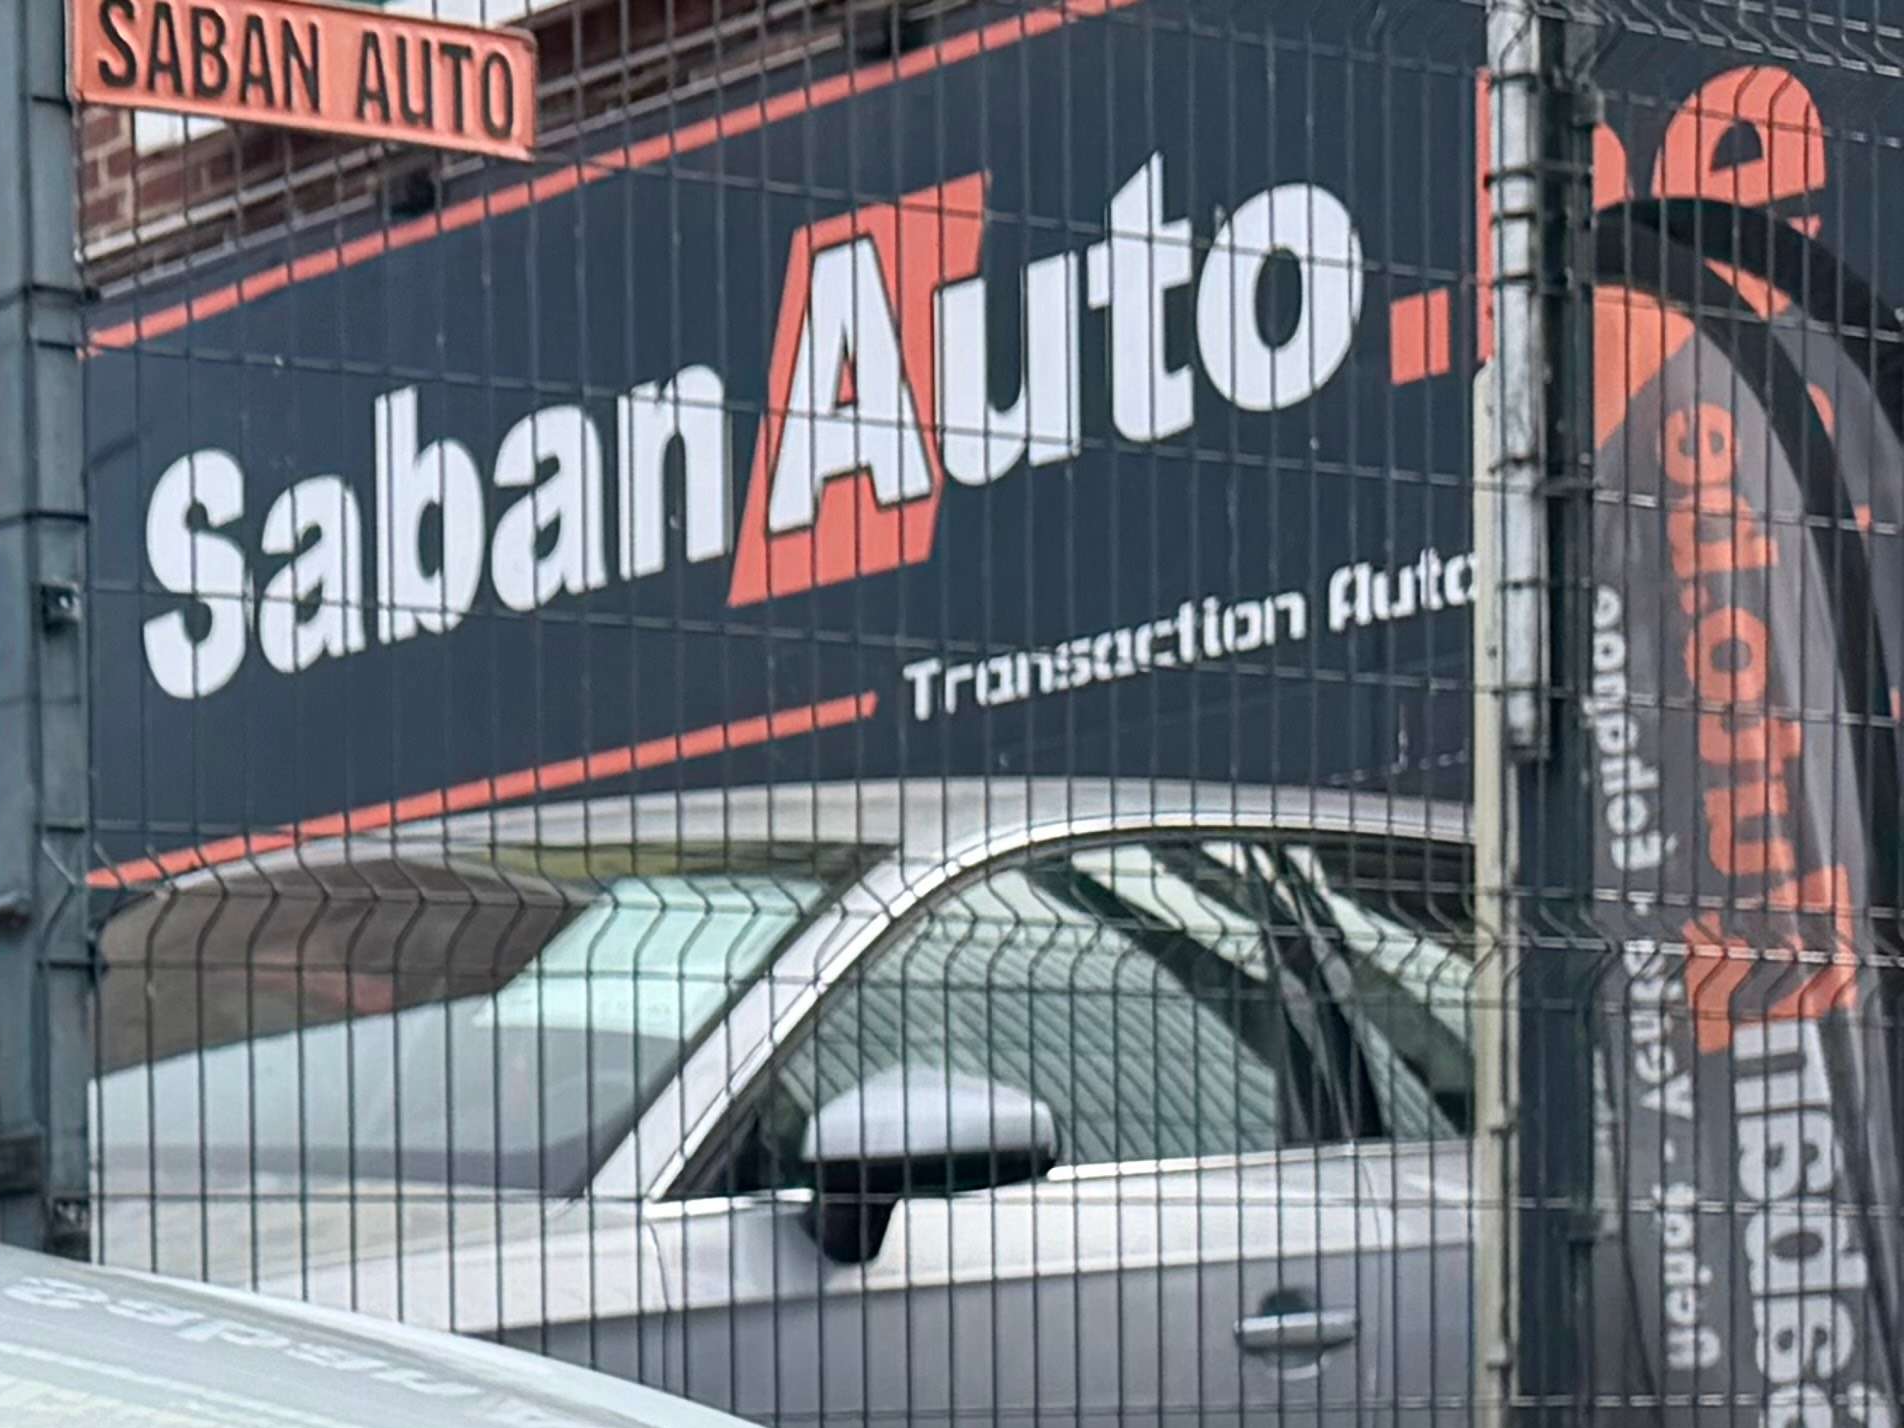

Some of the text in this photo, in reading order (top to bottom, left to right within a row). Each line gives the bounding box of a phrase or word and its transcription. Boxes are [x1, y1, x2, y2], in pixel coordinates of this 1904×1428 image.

[97, 0, 515, 140] SABAN AUTO
[902, 596, 1306, 721] Transaction
